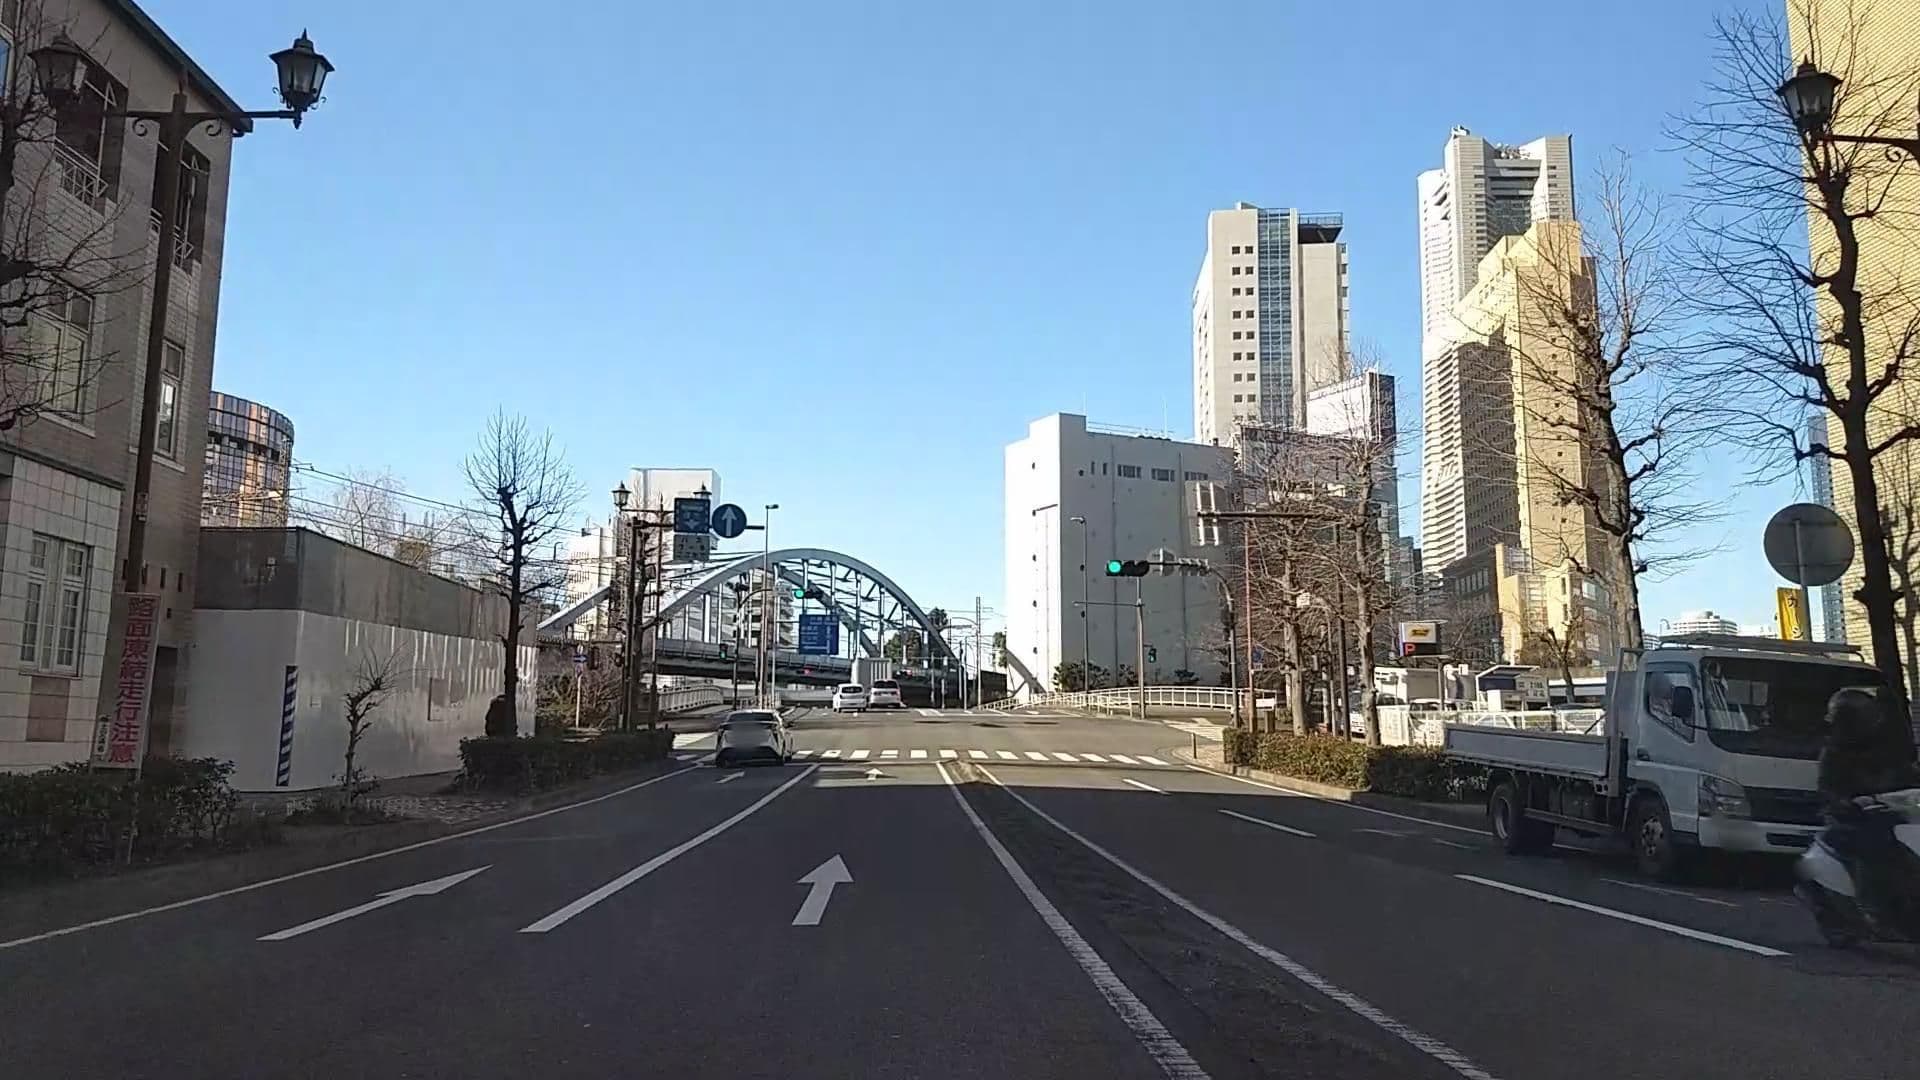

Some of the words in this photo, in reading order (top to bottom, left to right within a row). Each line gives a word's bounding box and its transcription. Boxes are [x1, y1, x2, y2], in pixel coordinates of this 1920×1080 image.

[109, 597, 155, 764] 路面凍結走行注意
[1404, 643, 1416, 656] P
